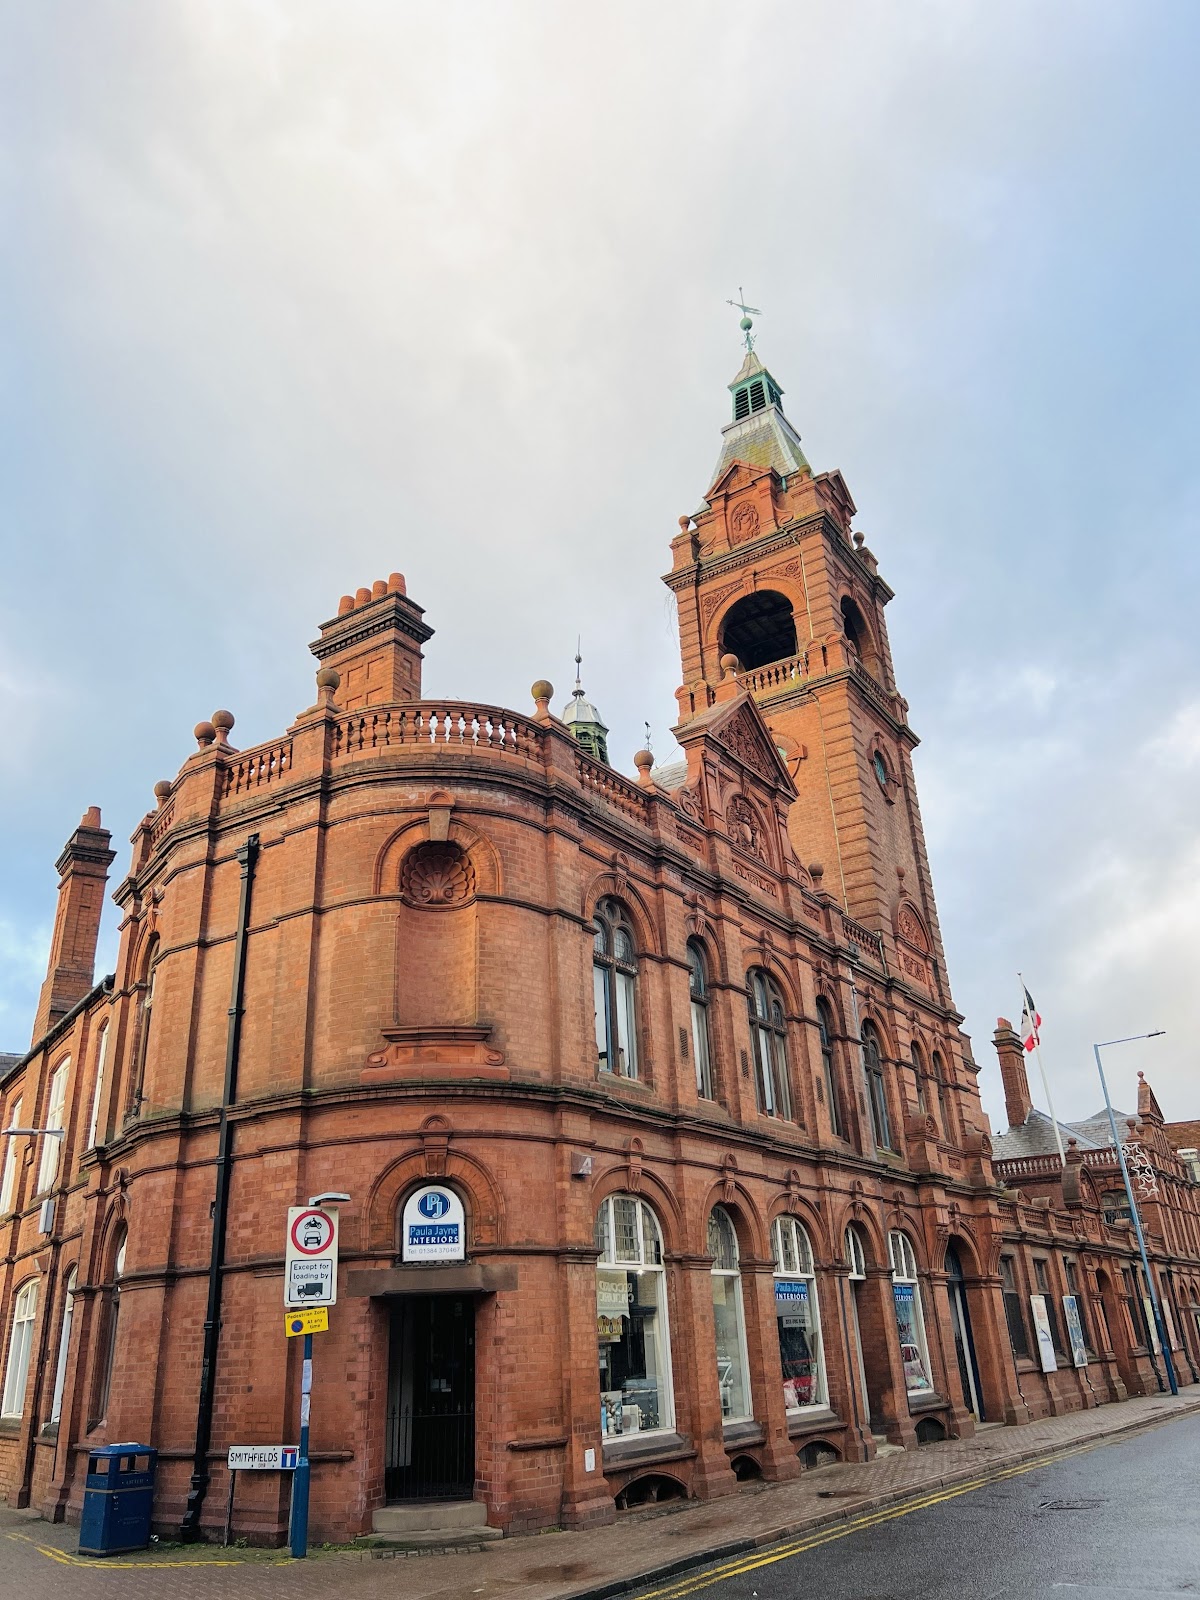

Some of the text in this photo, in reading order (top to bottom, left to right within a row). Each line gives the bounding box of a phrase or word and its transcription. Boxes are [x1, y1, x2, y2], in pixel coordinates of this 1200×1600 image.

[427, 1194, 442, 1218] PJ
[411, 1226, 457, 1236] Paula Jayne
[409, 1236, 459, 1244] INTERIORS
[775, 1283, 807, 1293] Paula Jayne
[230, 1453, 278, 1462] SMITHFIELDS
